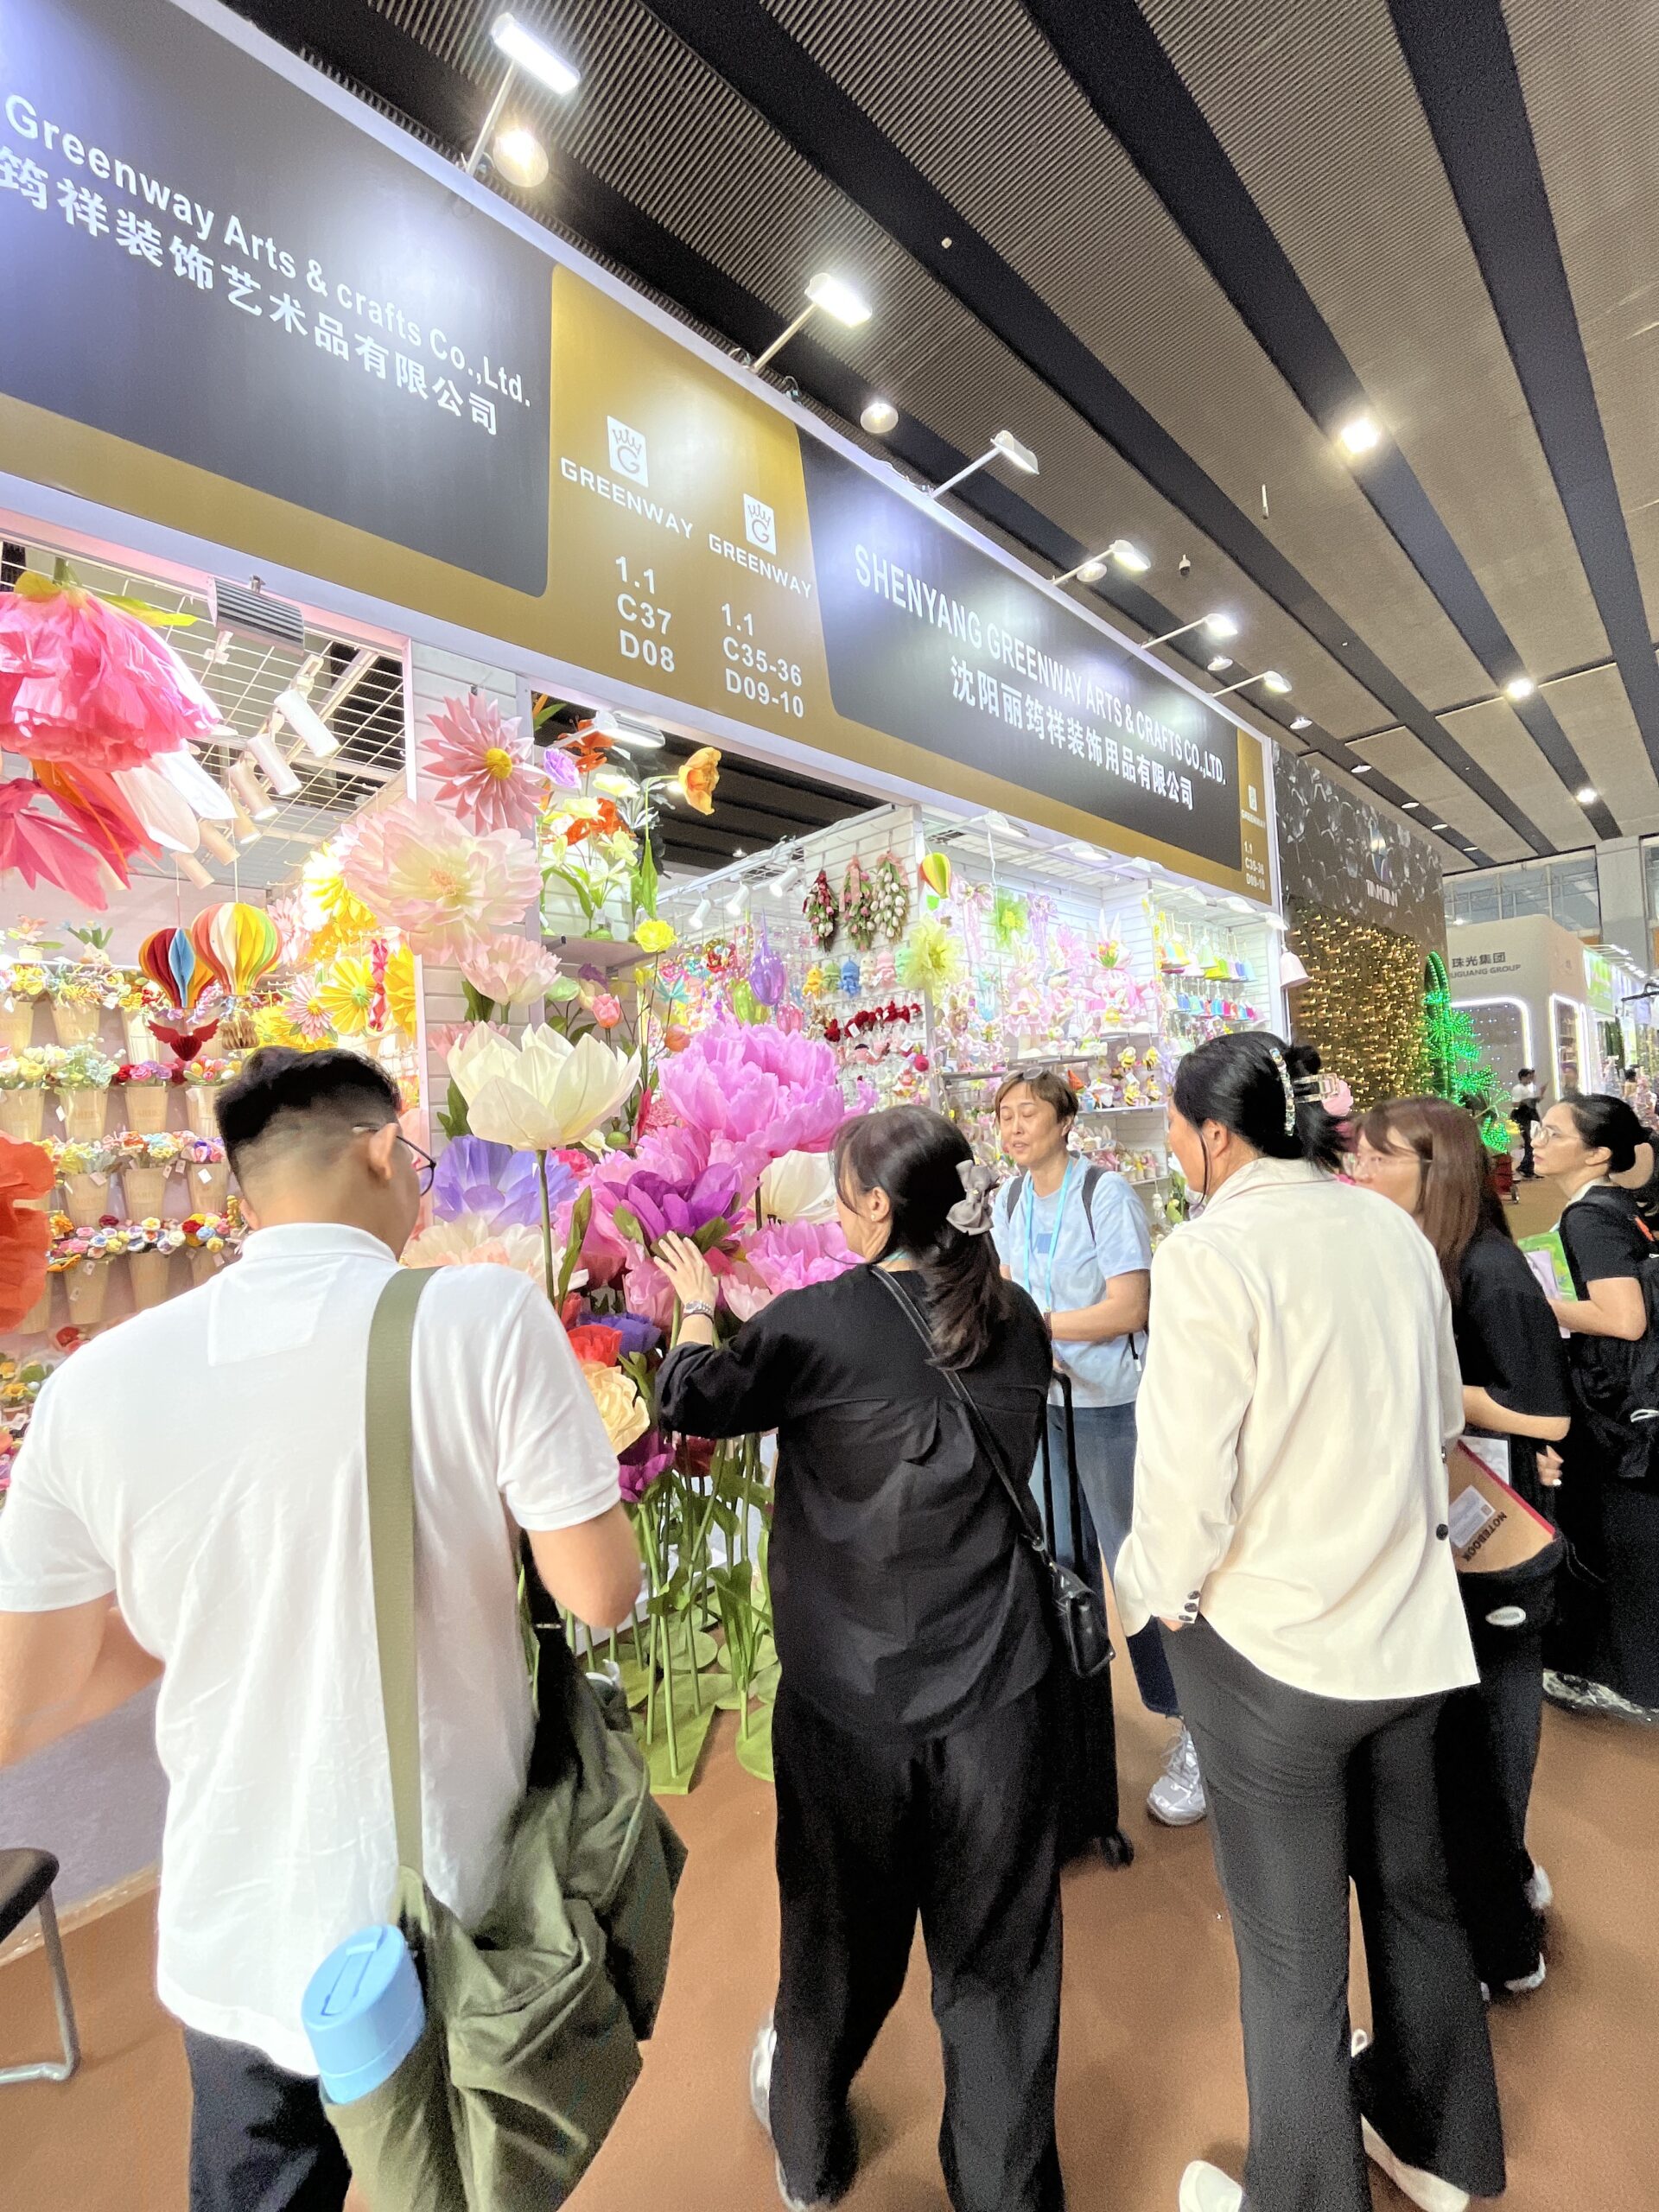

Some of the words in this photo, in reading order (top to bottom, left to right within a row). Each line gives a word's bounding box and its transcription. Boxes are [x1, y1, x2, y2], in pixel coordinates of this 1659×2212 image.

[5, 94, 214, 239] Greenway
[224, 215, 296, 279] Arts
[306, 259, 328, 296] &
[337, 283, 422, 346] crafts
[429, 328, 531, 407] Co.,Ltd.
[560, 457, 693, 539] GREENWAY
[615, 556, 655, 594] 1.1
[709, 533, 811, 599] GREENWAY
[617, 594, 672, 634] C37
[721, 603, 754, 636] 1.1
[620, 629, 675, 672] D08
[722, 636, 803, 687] C35-36
[855, 544, 982, 649] SHENYANG
[987, 623, 1082, 706] GREENWAY
[1086, 681, 1122, 728] ARTS
[1125, 704, 1135, 734] &
[1136, 710, 1183, 761] CRAFTS
[725, 668, 804, 718] D09-10
[950, 655, 1193, 810] 沈阳丽筠祥装饰用品有限公司
[1244, 841, 1253, 855] 1.1
[1452, 951, 1506, 968] 珠光集团
[1490, 964, 1521, 975] GROUP
[1462, 1511, 1507, 1561] NOTEBOOK
